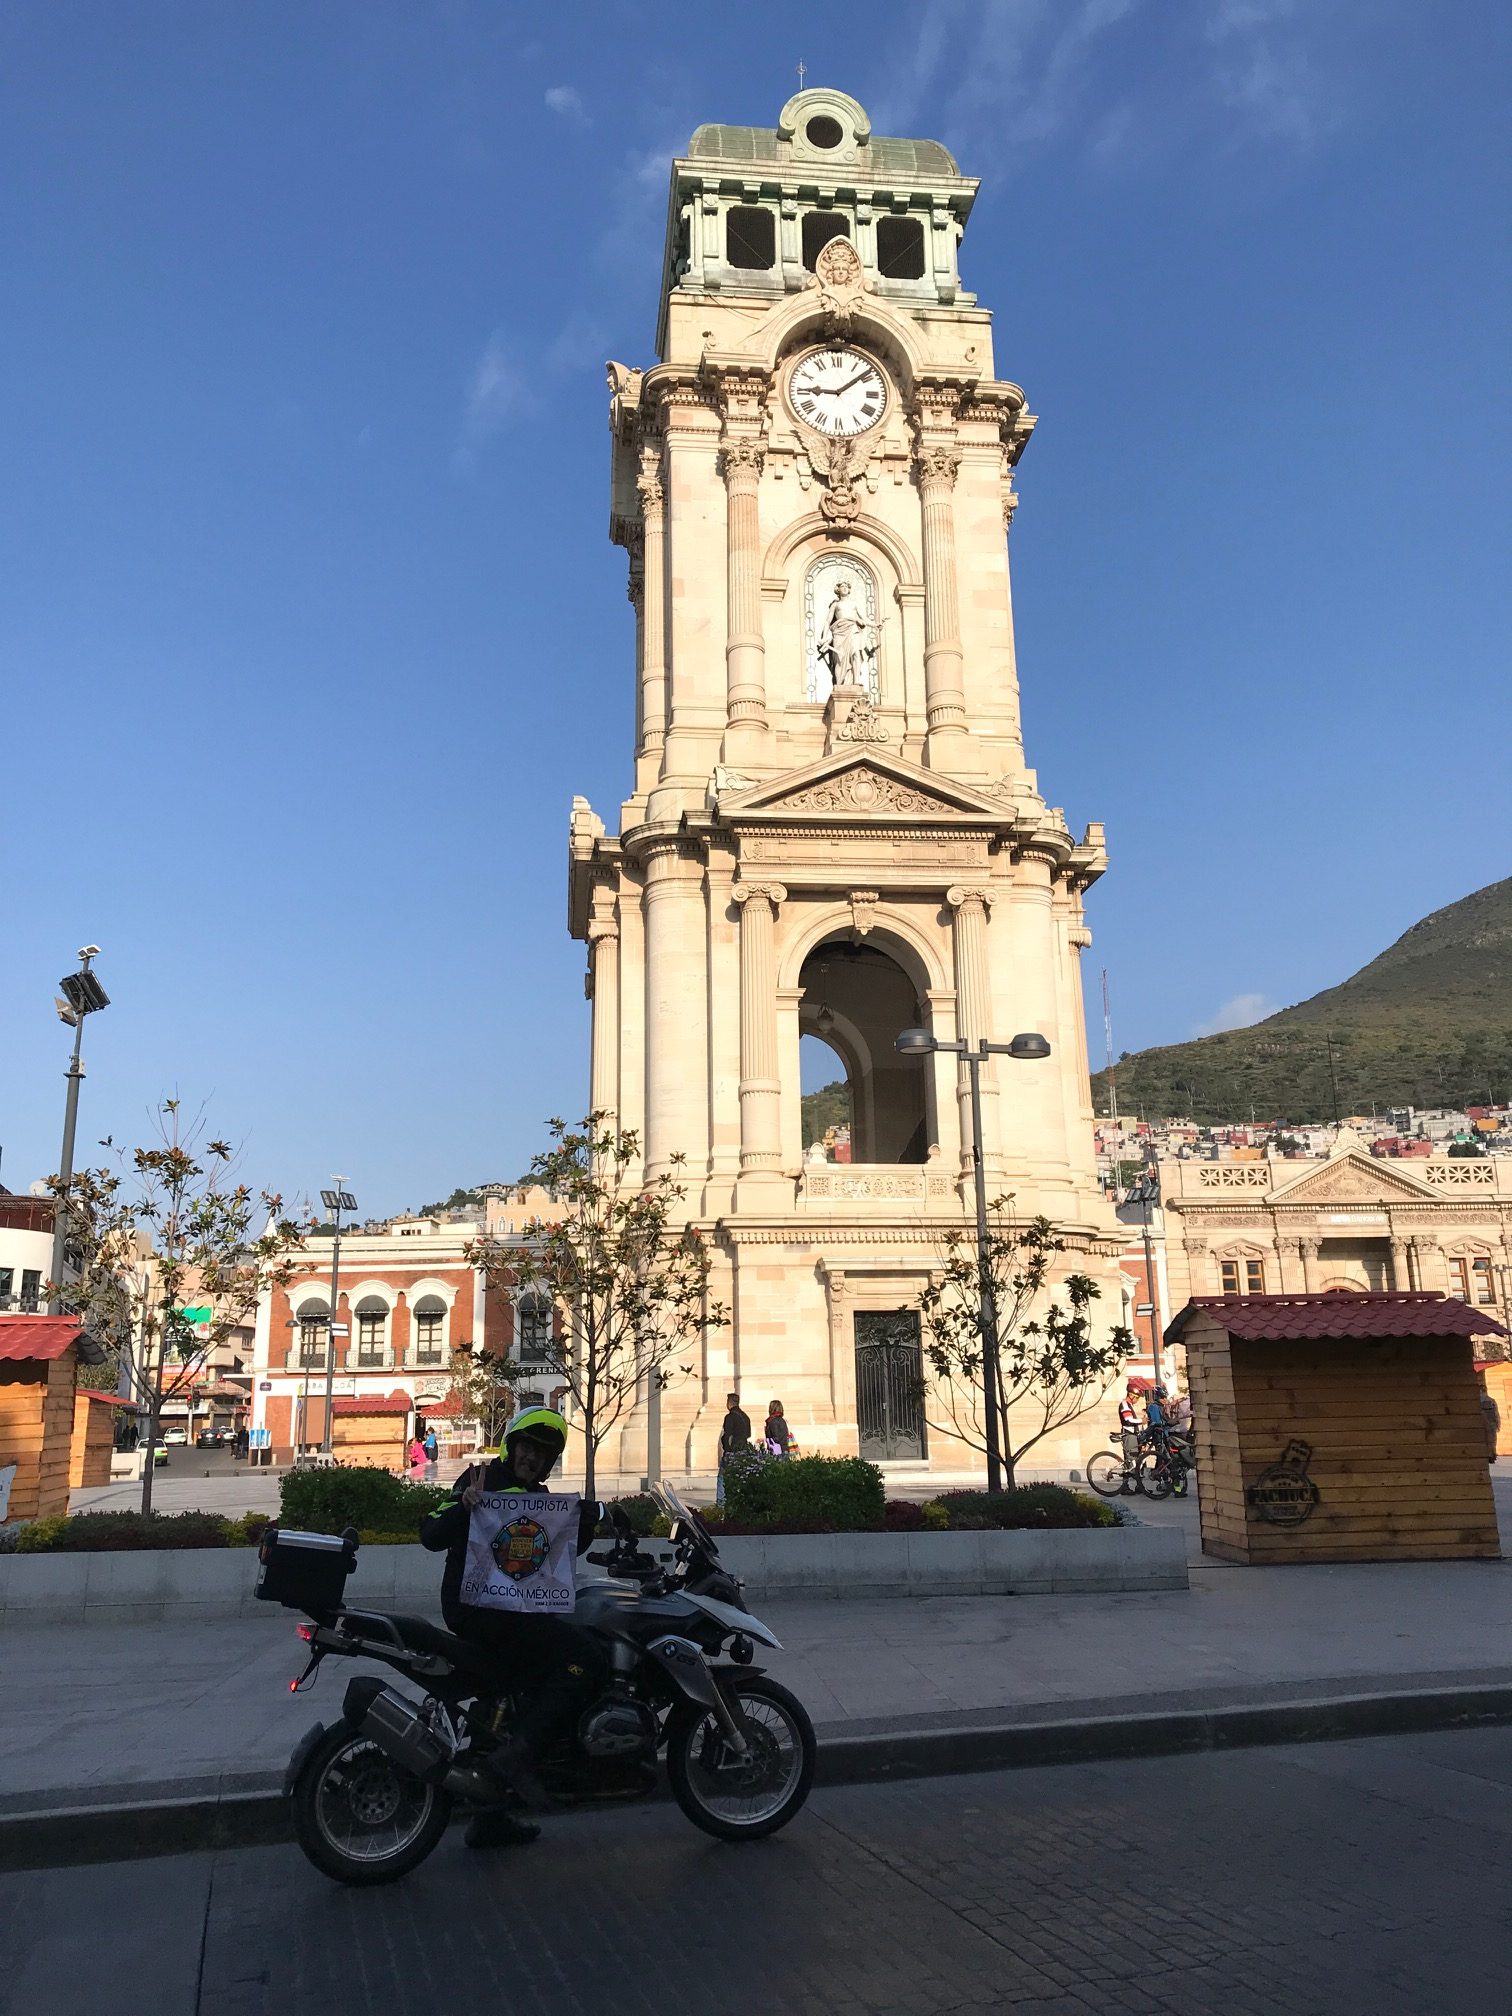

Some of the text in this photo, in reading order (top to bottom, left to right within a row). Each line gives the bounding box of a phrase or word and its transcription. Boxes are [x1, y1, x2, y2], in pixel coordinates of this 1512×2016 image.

[813, 358, 826, 372] XI
[831, 356, 842, 368] XII
[851, 362, 858, 372] I
[801, 371, 814, 381] X
[866, 391, 879, 399] III
[800, 400, 817, 415] VIII
[814, 412, 828, 426] VII
[835, 417, 843, 430] VI
[852, 415, 861, 427] V
[851, 722, 878, 738] 1810
[480, 1498, 569, 1512] MOTO TURISTA
[465, 1581, 570, 1599] EN ACCIÓN MÉXICO
